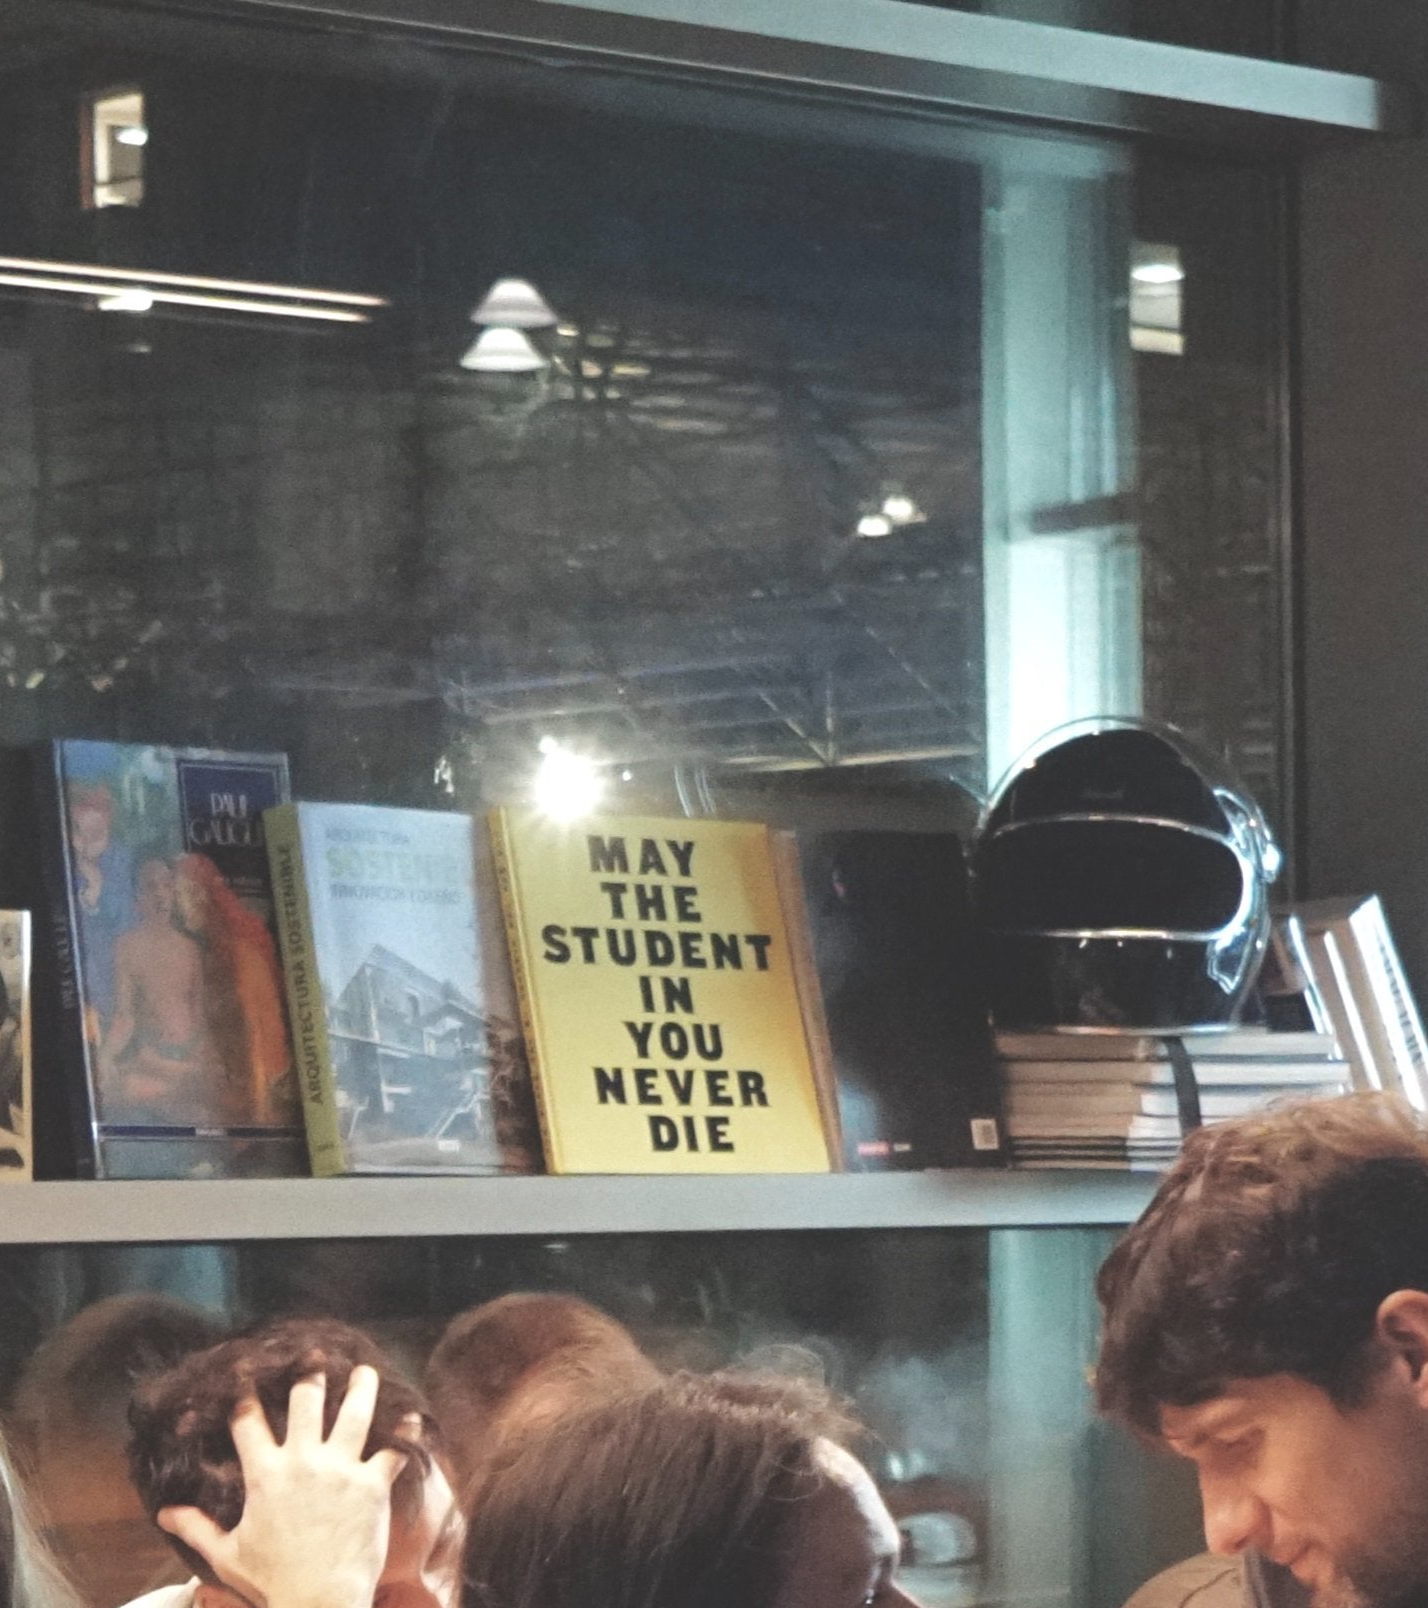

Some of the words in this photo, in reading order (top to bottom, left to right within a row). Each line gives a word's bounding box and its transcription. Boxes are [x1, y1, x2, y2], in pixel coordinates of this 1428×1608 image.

[587, 834, 695, 878] MAY
[276, 844, 305, 956] SOSTENIBLE
[600, 882, 702, 923] THE
[542, 925, 772, 972] STUDENT
[640, 975, 694, 1015] IN
[293, 960, 323, 1106] ARQUITECTURA
[624, 1020, 723, 1062] YOU
[595, 1066, 770, 1109] NEVER
[648, 1115, 736, 1154] DIE
